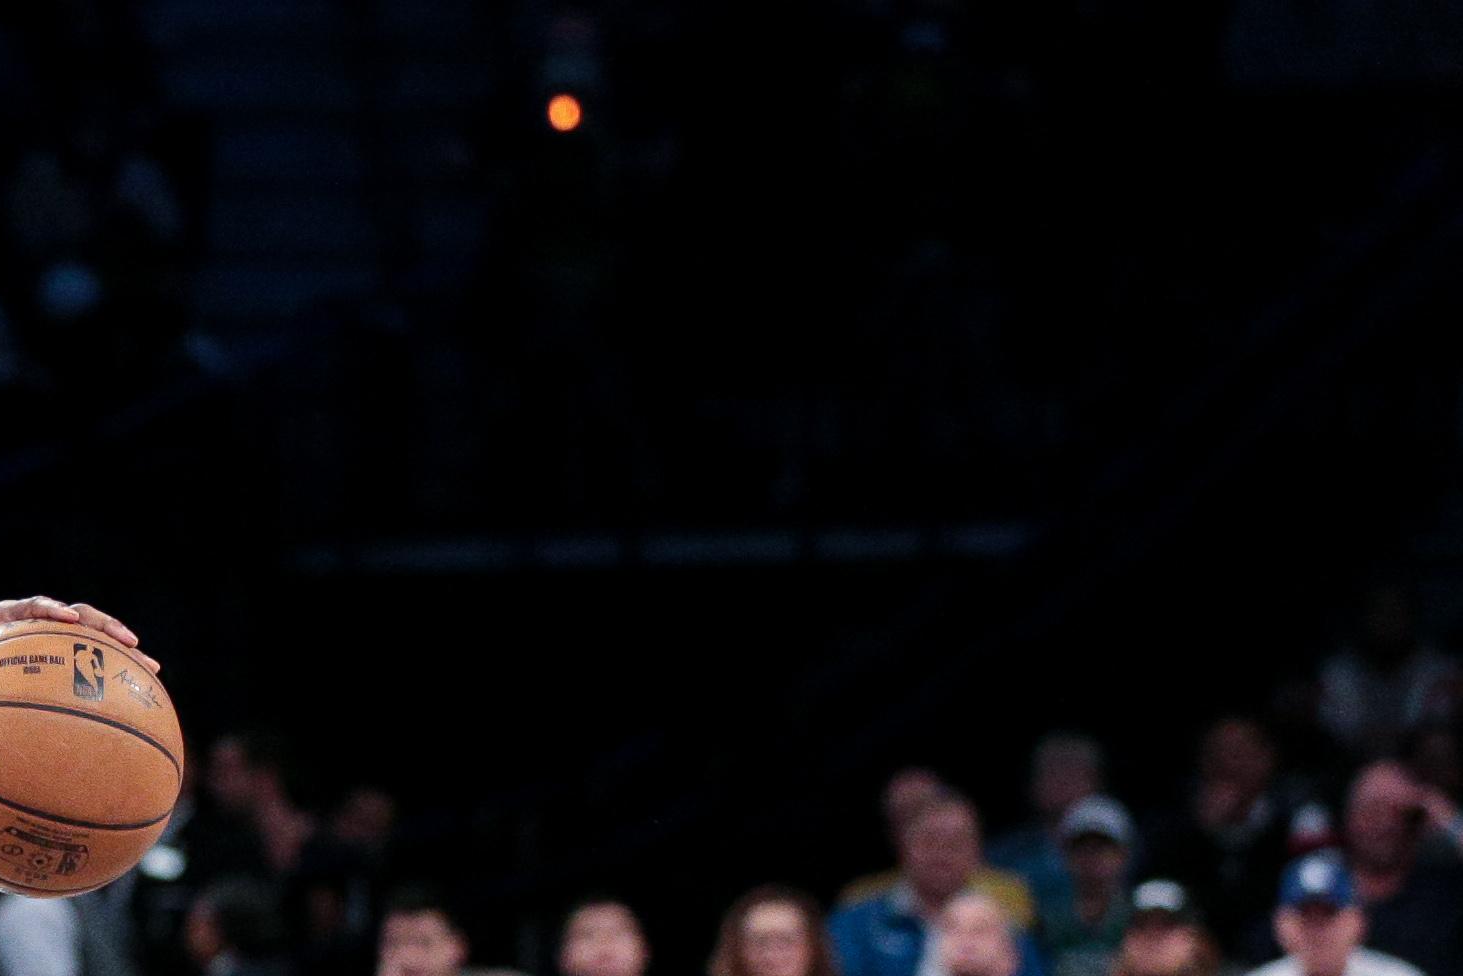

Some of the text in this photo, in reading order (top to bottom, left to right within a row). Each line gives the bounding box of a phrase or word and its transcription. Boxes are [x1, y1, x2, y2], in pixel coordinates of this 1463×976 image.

[0, 654, 66, 667] OFFICIAL GAME BALL
